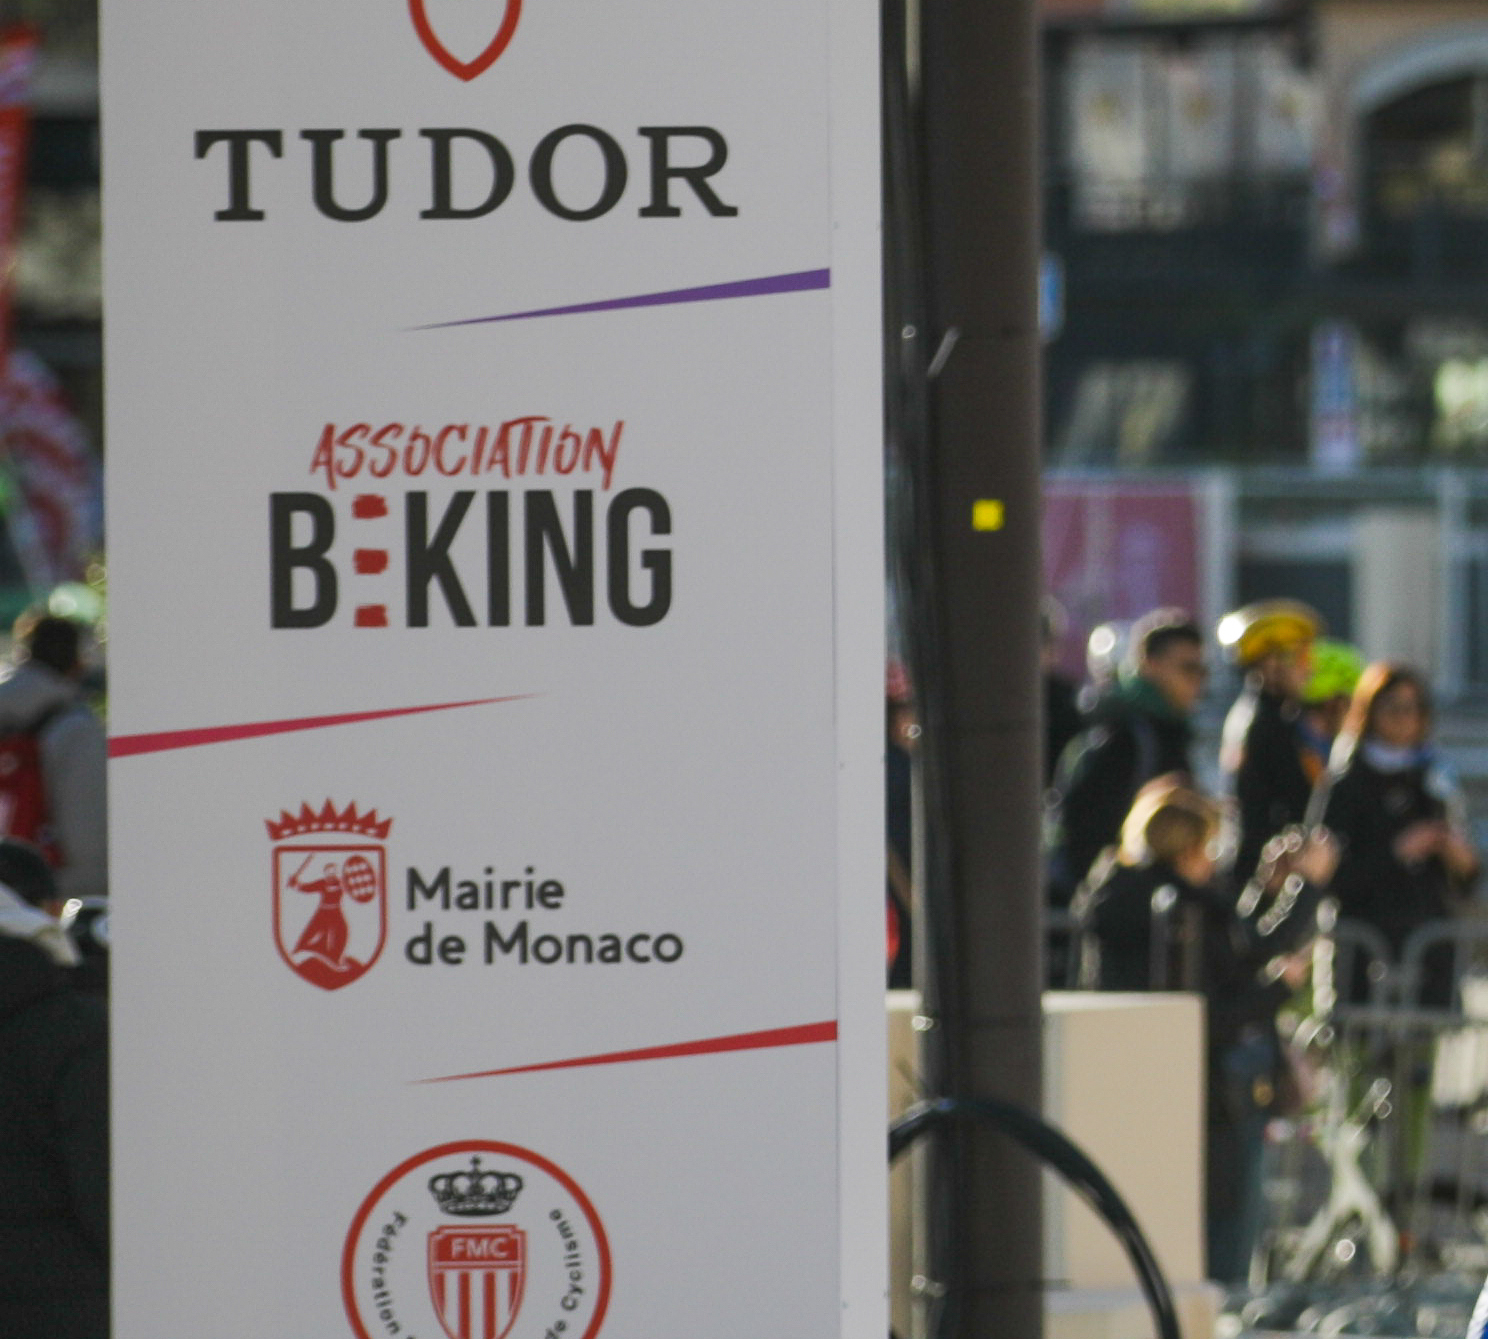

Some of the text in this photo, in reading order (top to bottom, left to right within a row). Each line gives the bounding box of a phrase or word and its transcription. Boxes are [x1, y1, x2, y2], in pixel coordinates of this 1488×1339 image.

[193, 123, 739, 223] TUDOR
[308, 415, 626, 491] ASSOCIATION
[406, 865, 566, 912] Mairie
[404, 919, 685, 966] de Monaco
[371, 1211, 408, 1336] Fédération
[549, 1208, 585, 1312] Cyclisme
[451, 1237, 508, 1258] FMC
